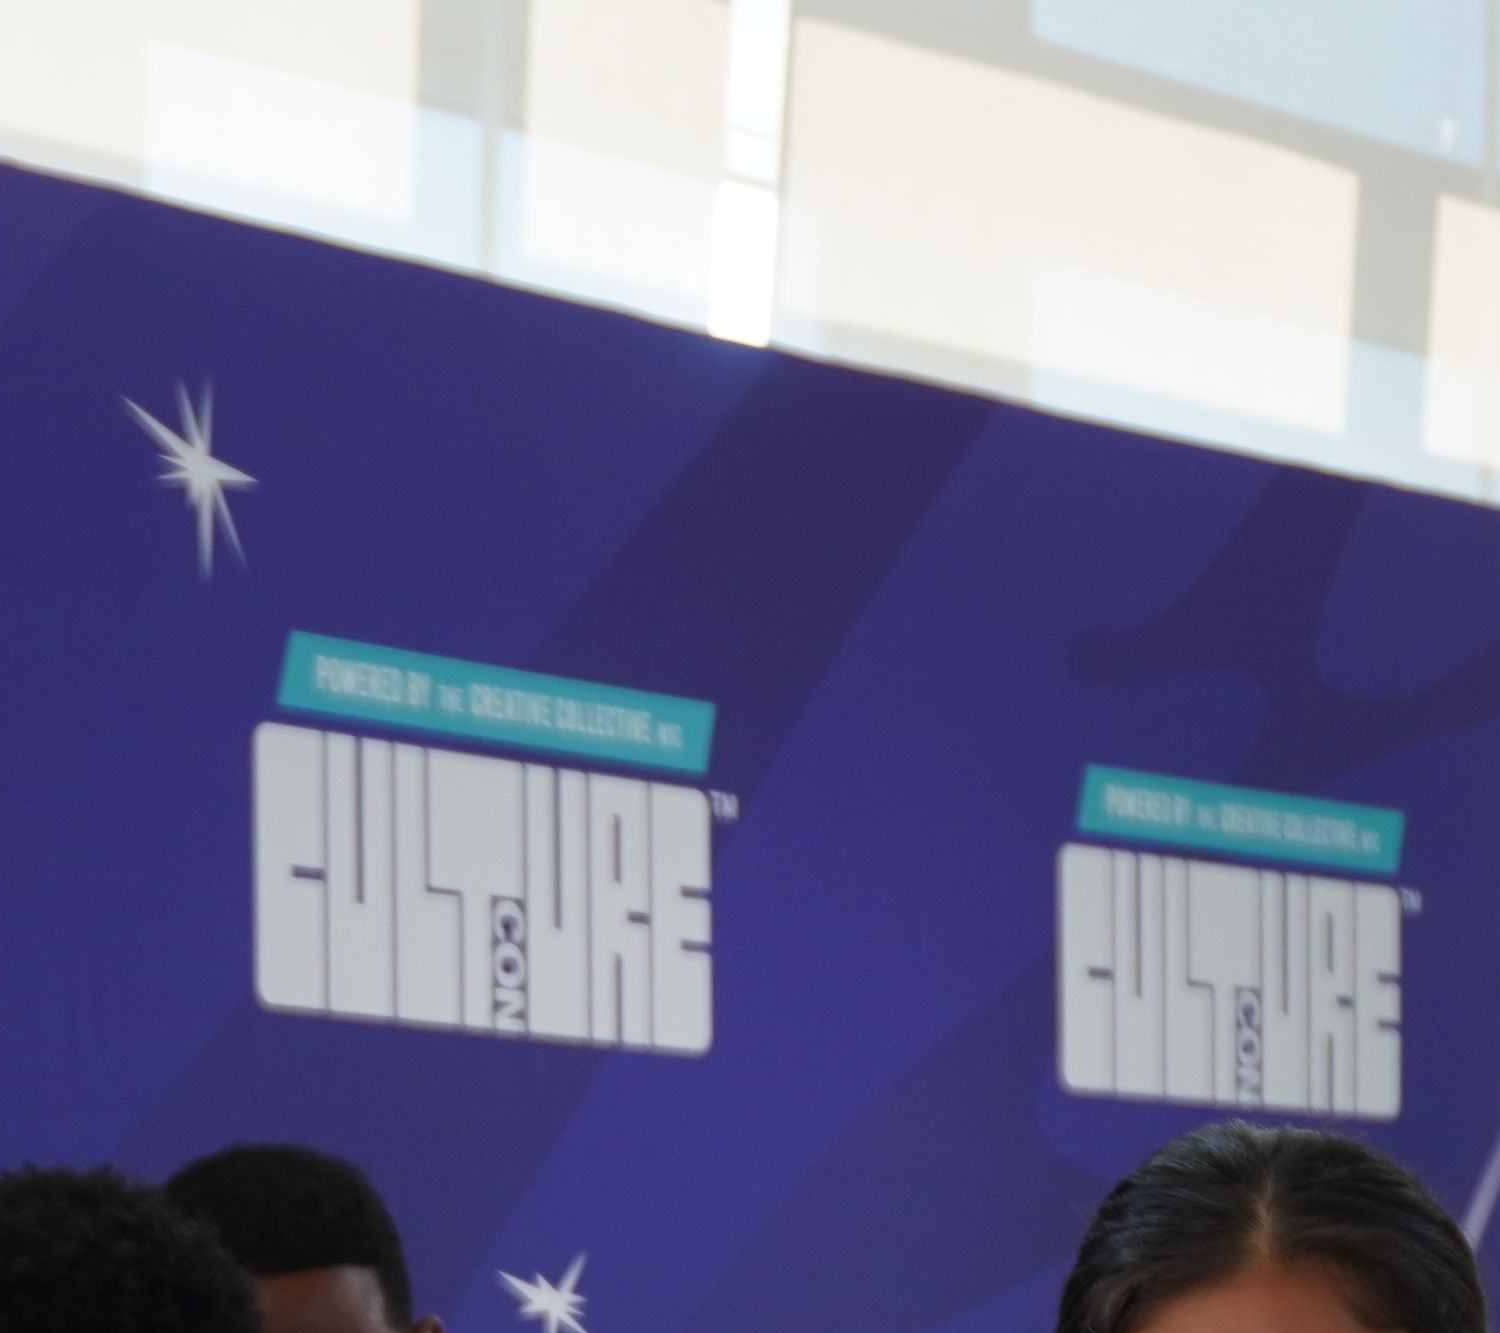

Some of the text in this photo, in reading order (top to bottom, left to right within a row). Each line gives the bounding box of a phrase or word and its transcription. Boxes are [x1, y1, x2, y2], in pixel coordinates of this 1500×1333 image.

[251, 719, 714, 1058] CULTURE
[493, 897, 527, 1032] CON
[1056, 841, 1402, 1122] CULTURE
